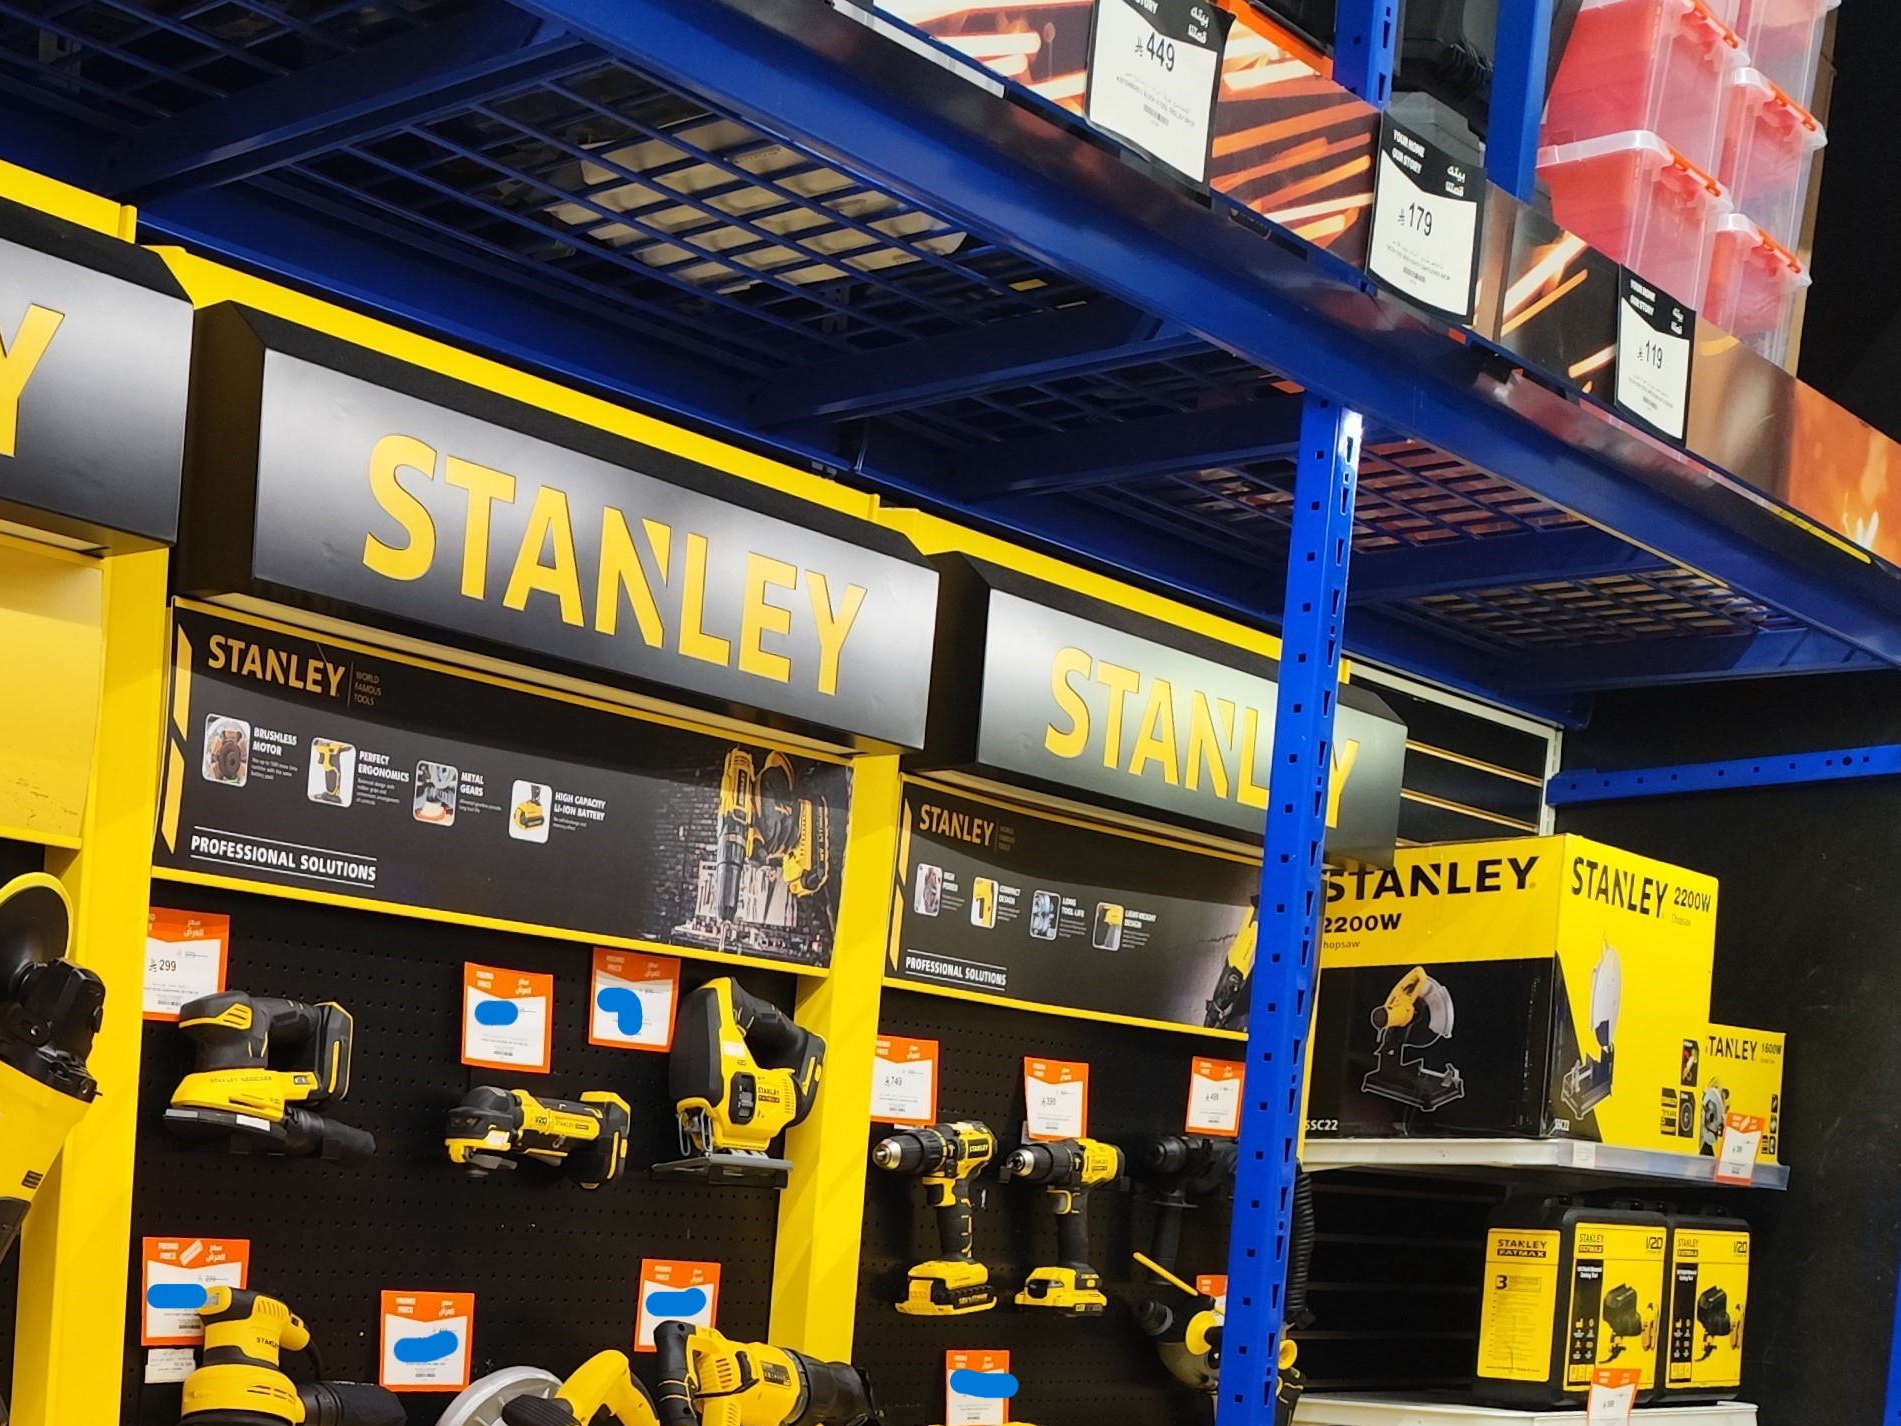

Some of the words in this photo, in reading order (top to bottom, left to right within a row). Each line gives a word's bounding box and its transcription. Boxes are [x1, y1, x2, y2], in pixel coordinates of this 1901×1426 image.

[1146, 32, 1175, 72] 449
[1408, 201, 1433, 237] 179
[1645, 340, 1663, 370] 119
[363, 433, 867, 696] STANLEY
[208, 634, 346, 697] STANLEY
[355, 671, 380, 684] WORLD
[354, 682, 382, 696] FAMOUS
[353, 693, 375, 706] TOOLS
[254, 727, 298, 746] BRUSHLESS
[252, 741, 282, 756] MOTOR
[359, 750, 390, 766] PERFECT
[358, 764, 410, 783] ERGONOMICS
[461, 771, 484, 785] METAL
[460, 783, 484, 797] GEARS
[555, 791, 574, 804] HIGH
[574, 795, 607, 810] CAPACITY
[577, 807, 605, 821] BATTERY
[919, 804, 994, 846] STANLEY
[191, 835, 296, 868] PROFESSIONAL
[300, 855, 377, 881] SOLUTIONS
[1571, 856, 1668, 919] STANLEY
[1674, 886, 1711, 913] 2200W
[159, 959, 177, 972] 299
[906, 956, 963, 979] PROFESSIONAL
[965, 967, 1007, 986] SOLUTIONS
[1497, 1238, 1547, 1249] STANLEY
[1496, 1275, 1508, 1290] 3
